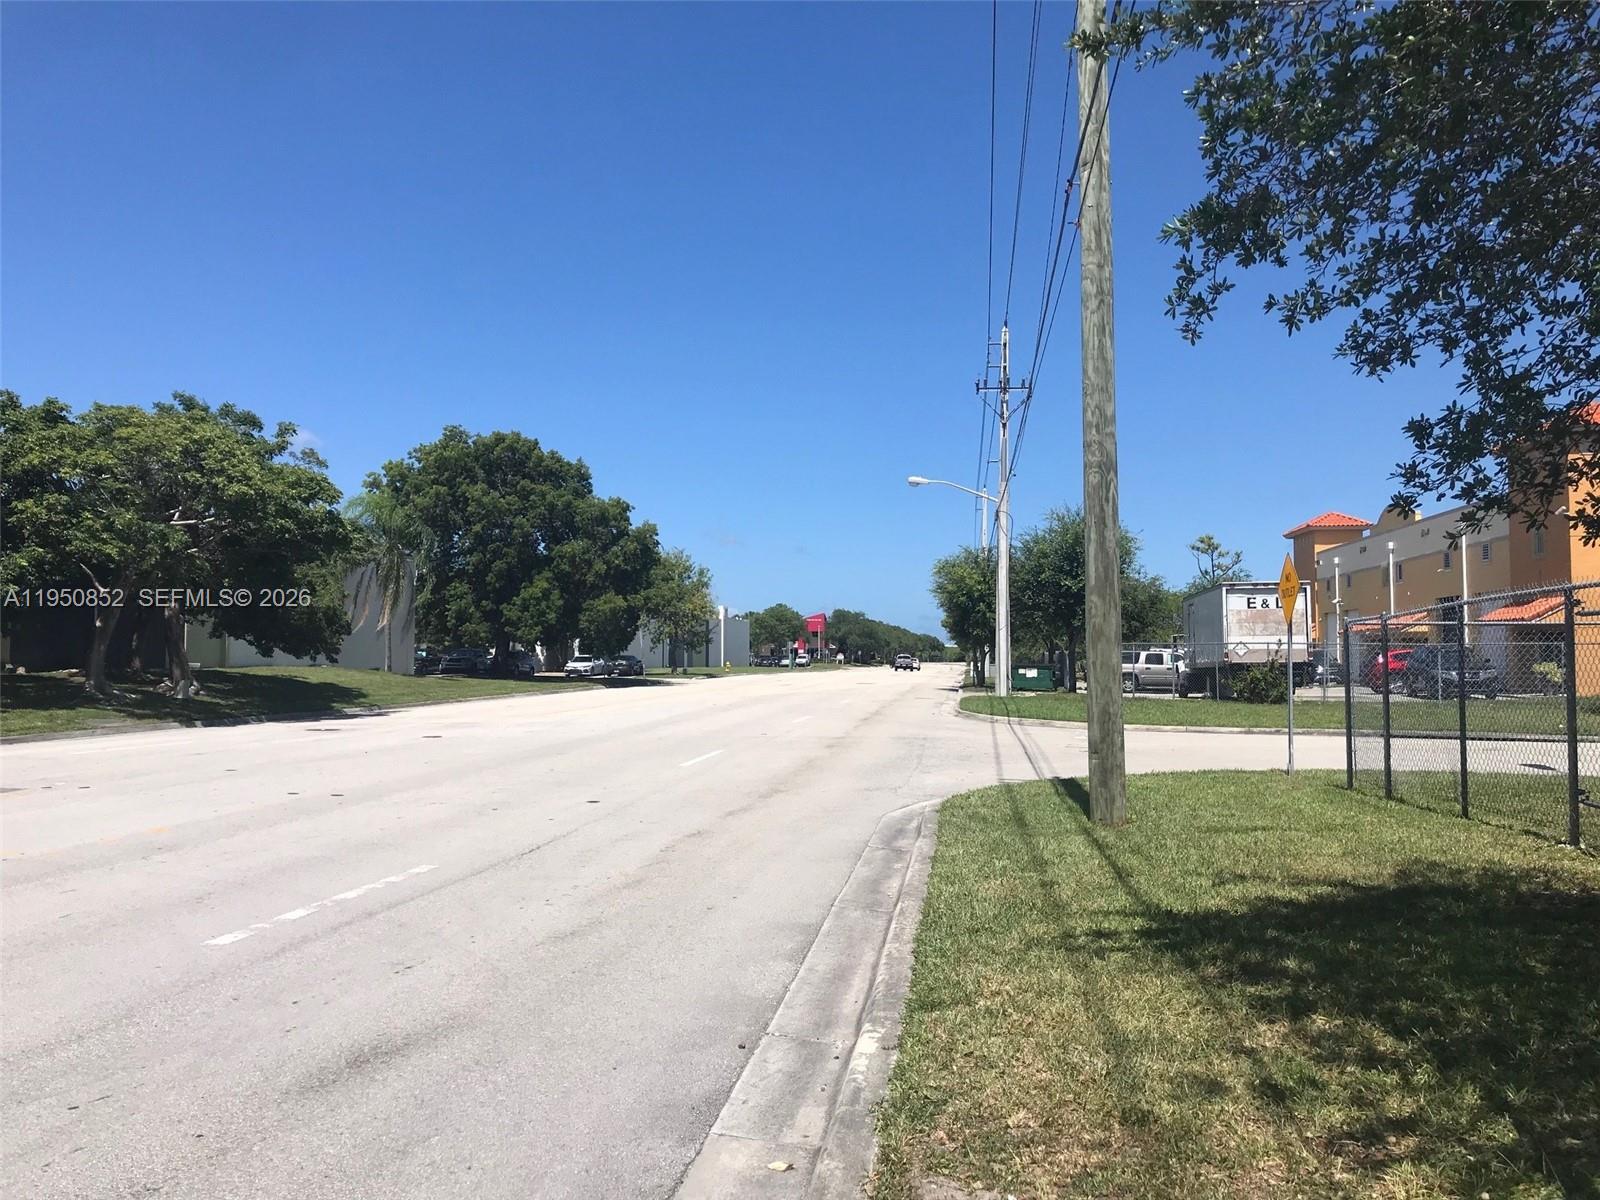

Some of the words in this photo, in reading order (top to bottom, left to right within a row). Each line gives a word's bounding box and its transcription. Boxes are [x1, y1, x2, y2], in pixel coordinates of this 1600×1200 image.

[1285, 571, 1292, 582] NO
[1247, 597, 1257, 609] E
[1260, 598, 1270, 609] &
